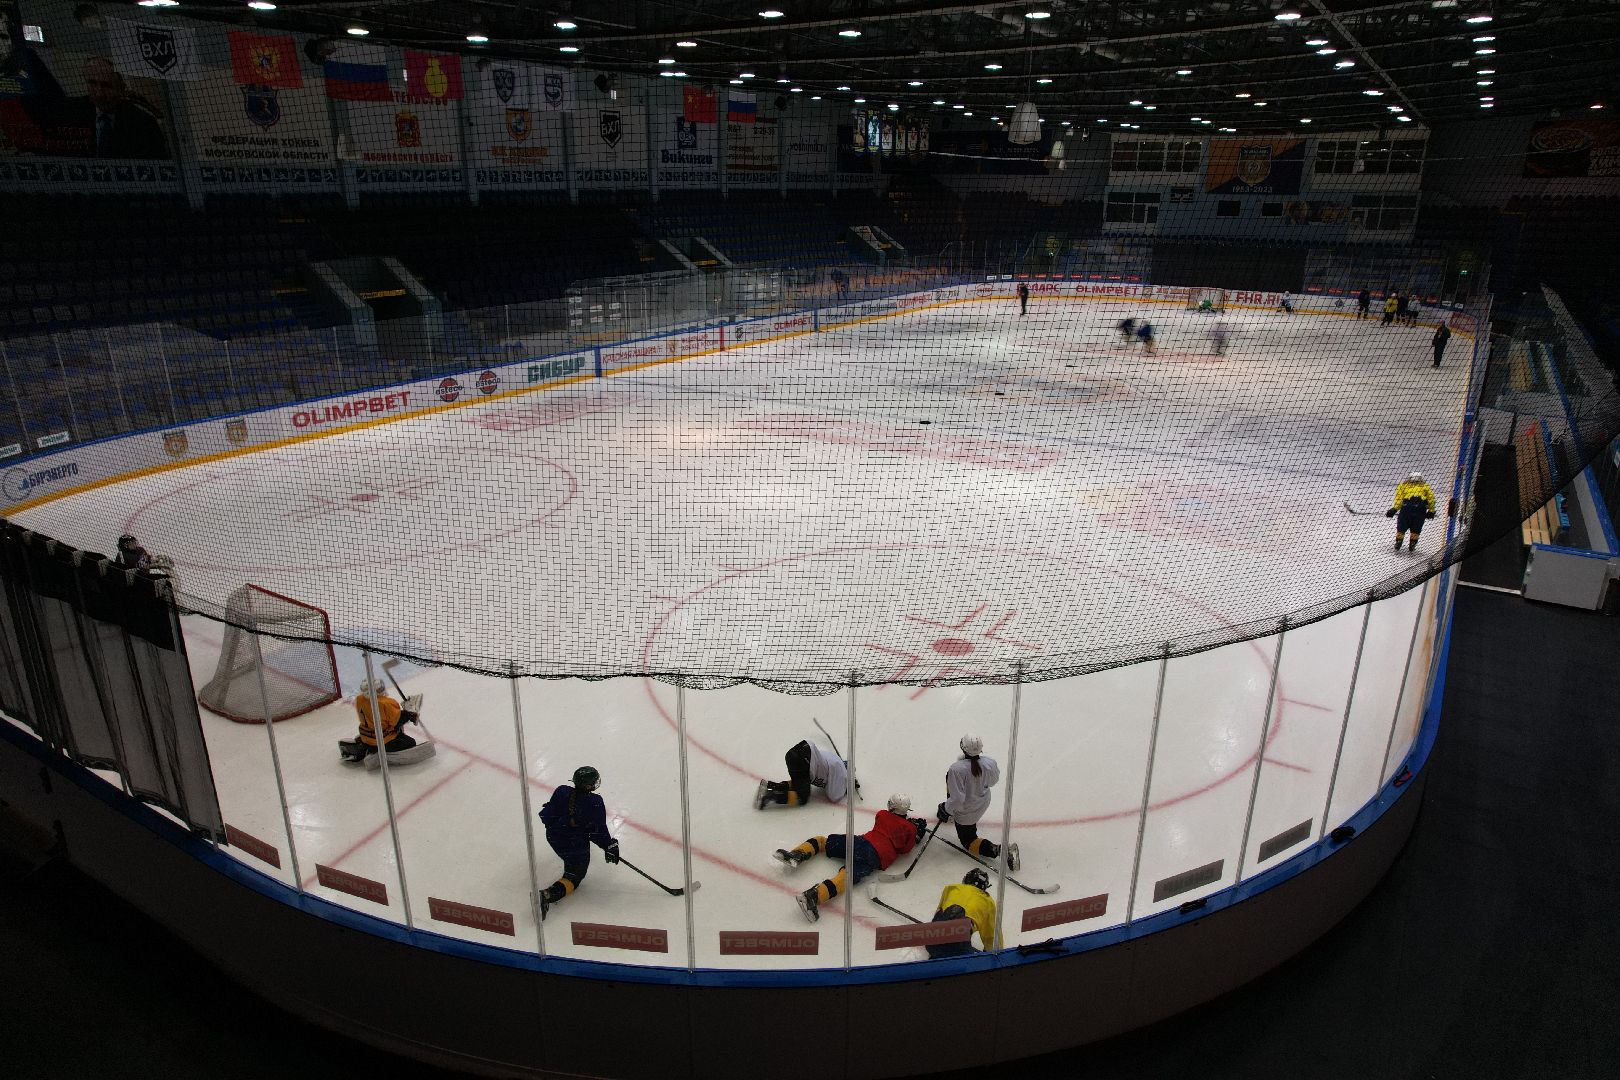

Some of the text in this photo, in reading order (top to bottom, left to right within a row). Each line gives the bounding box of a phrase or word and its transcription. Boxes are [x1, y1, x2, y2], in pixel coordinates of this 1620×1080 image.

[141, 40, 175, 58] ВХЛ
[211, 136, 320, 148] ФЕДЕРАЦИЯ ХОККЕЯ
[204, 148, 329, 160] МОСКОВСКОЙ ОБЛАСТИ
[1232, 185, 1273, 193] 1953-2023
[1075, 284, 1140, 295] OLIMPBET
[773, 316, 813, 331] OLIMPBET
[528, 357, 585, 383] СИБУР
[292, 391, 411, 428] OLIMPBET
